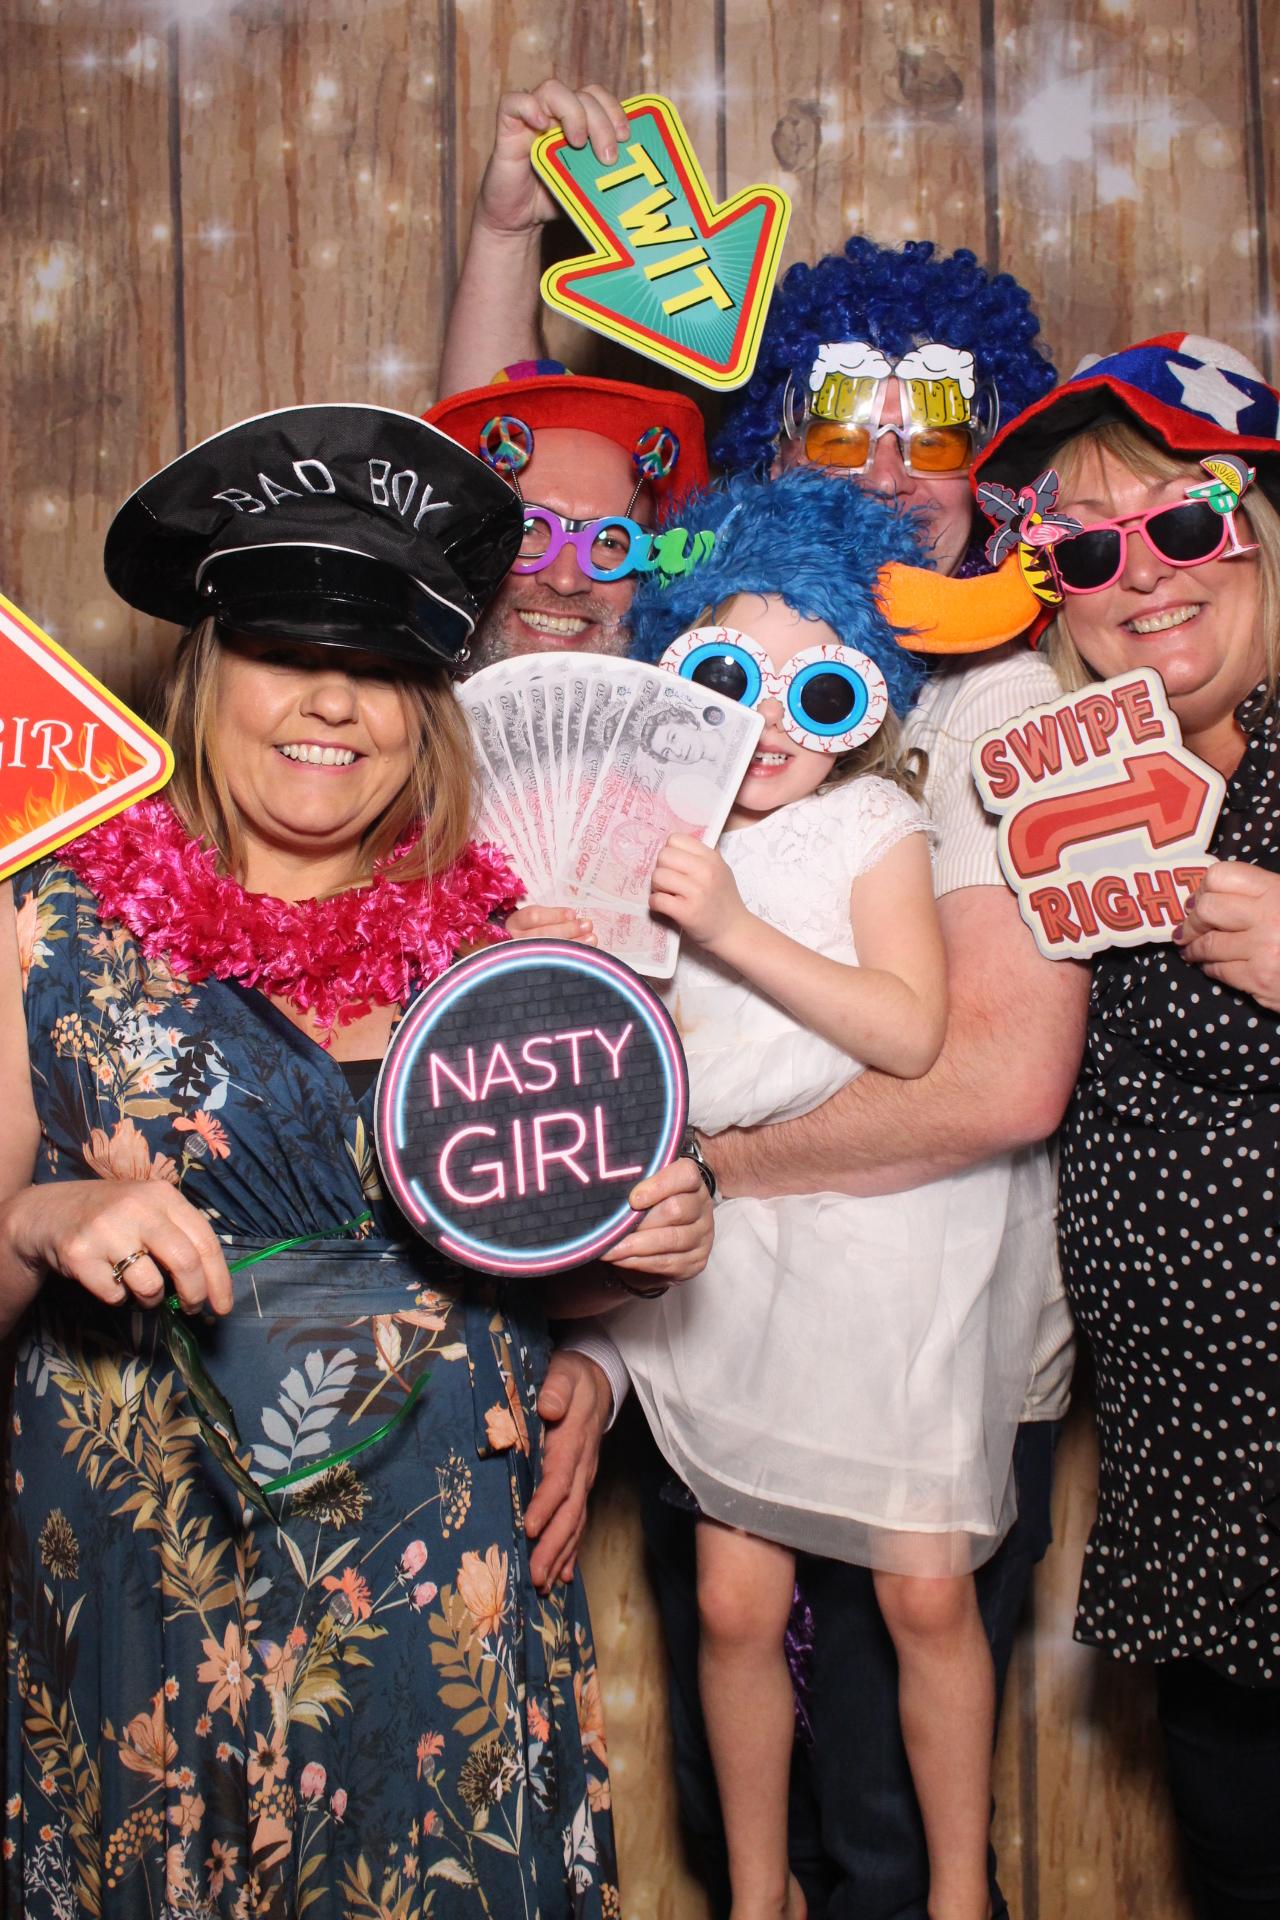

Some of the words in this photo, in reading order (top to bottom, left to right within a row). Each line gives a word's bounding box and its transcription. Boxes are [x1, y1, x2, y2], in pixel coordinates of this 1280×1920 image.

[594, 142, 737, 317] TWIT
[211, 458, 336, 514] BAD
[368, 457, 453, 531] BOY
[0, 717, 110, 785] IRL
[980, 679, 1165, 799] SWIPE
[428, 1022, 634, 1109] NASTY
[437, 1104, 643, 1205] GIRL
